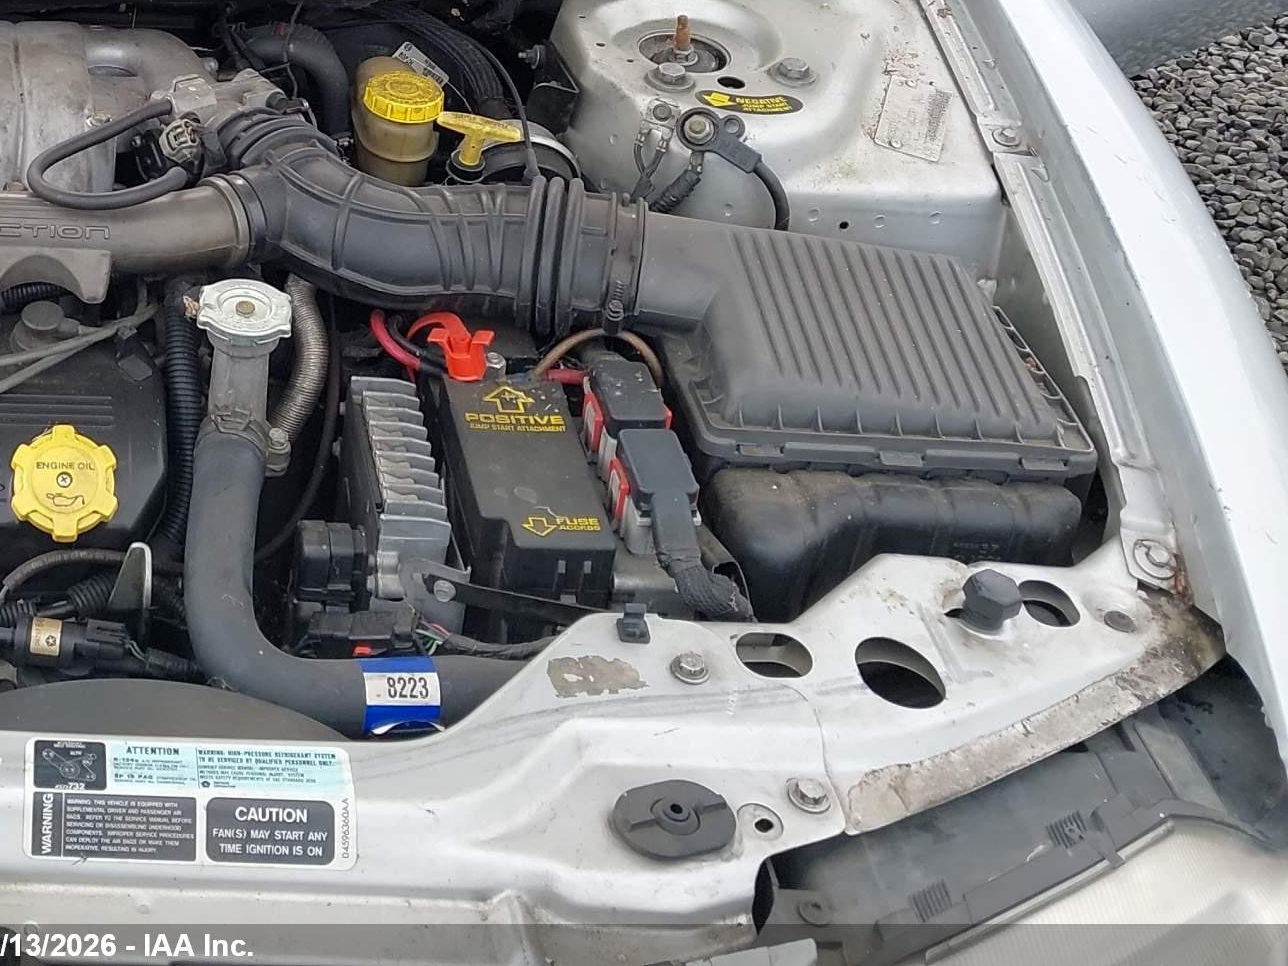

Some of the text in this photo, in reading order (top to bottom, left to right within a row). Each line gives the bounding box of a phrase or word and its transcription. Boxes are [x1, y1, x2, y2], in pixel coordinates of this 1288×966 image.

[464, 413, 565, 425] POSITIVE
[36, 461, 96, 471] ENGINE OIL
[555, 516, 600, 525] FUSE
[386, 676, 430, 700] 8223
[126, 746, 180, 756] ATTENTION
[234, 806, 308, 823] CAUTION
[41, 793, 54, 854] WARNING
[212, 828, 328, 842] FAN(S) MAY START ANY
[218, 843, 323, 857] TIME IGNITION IS ON
